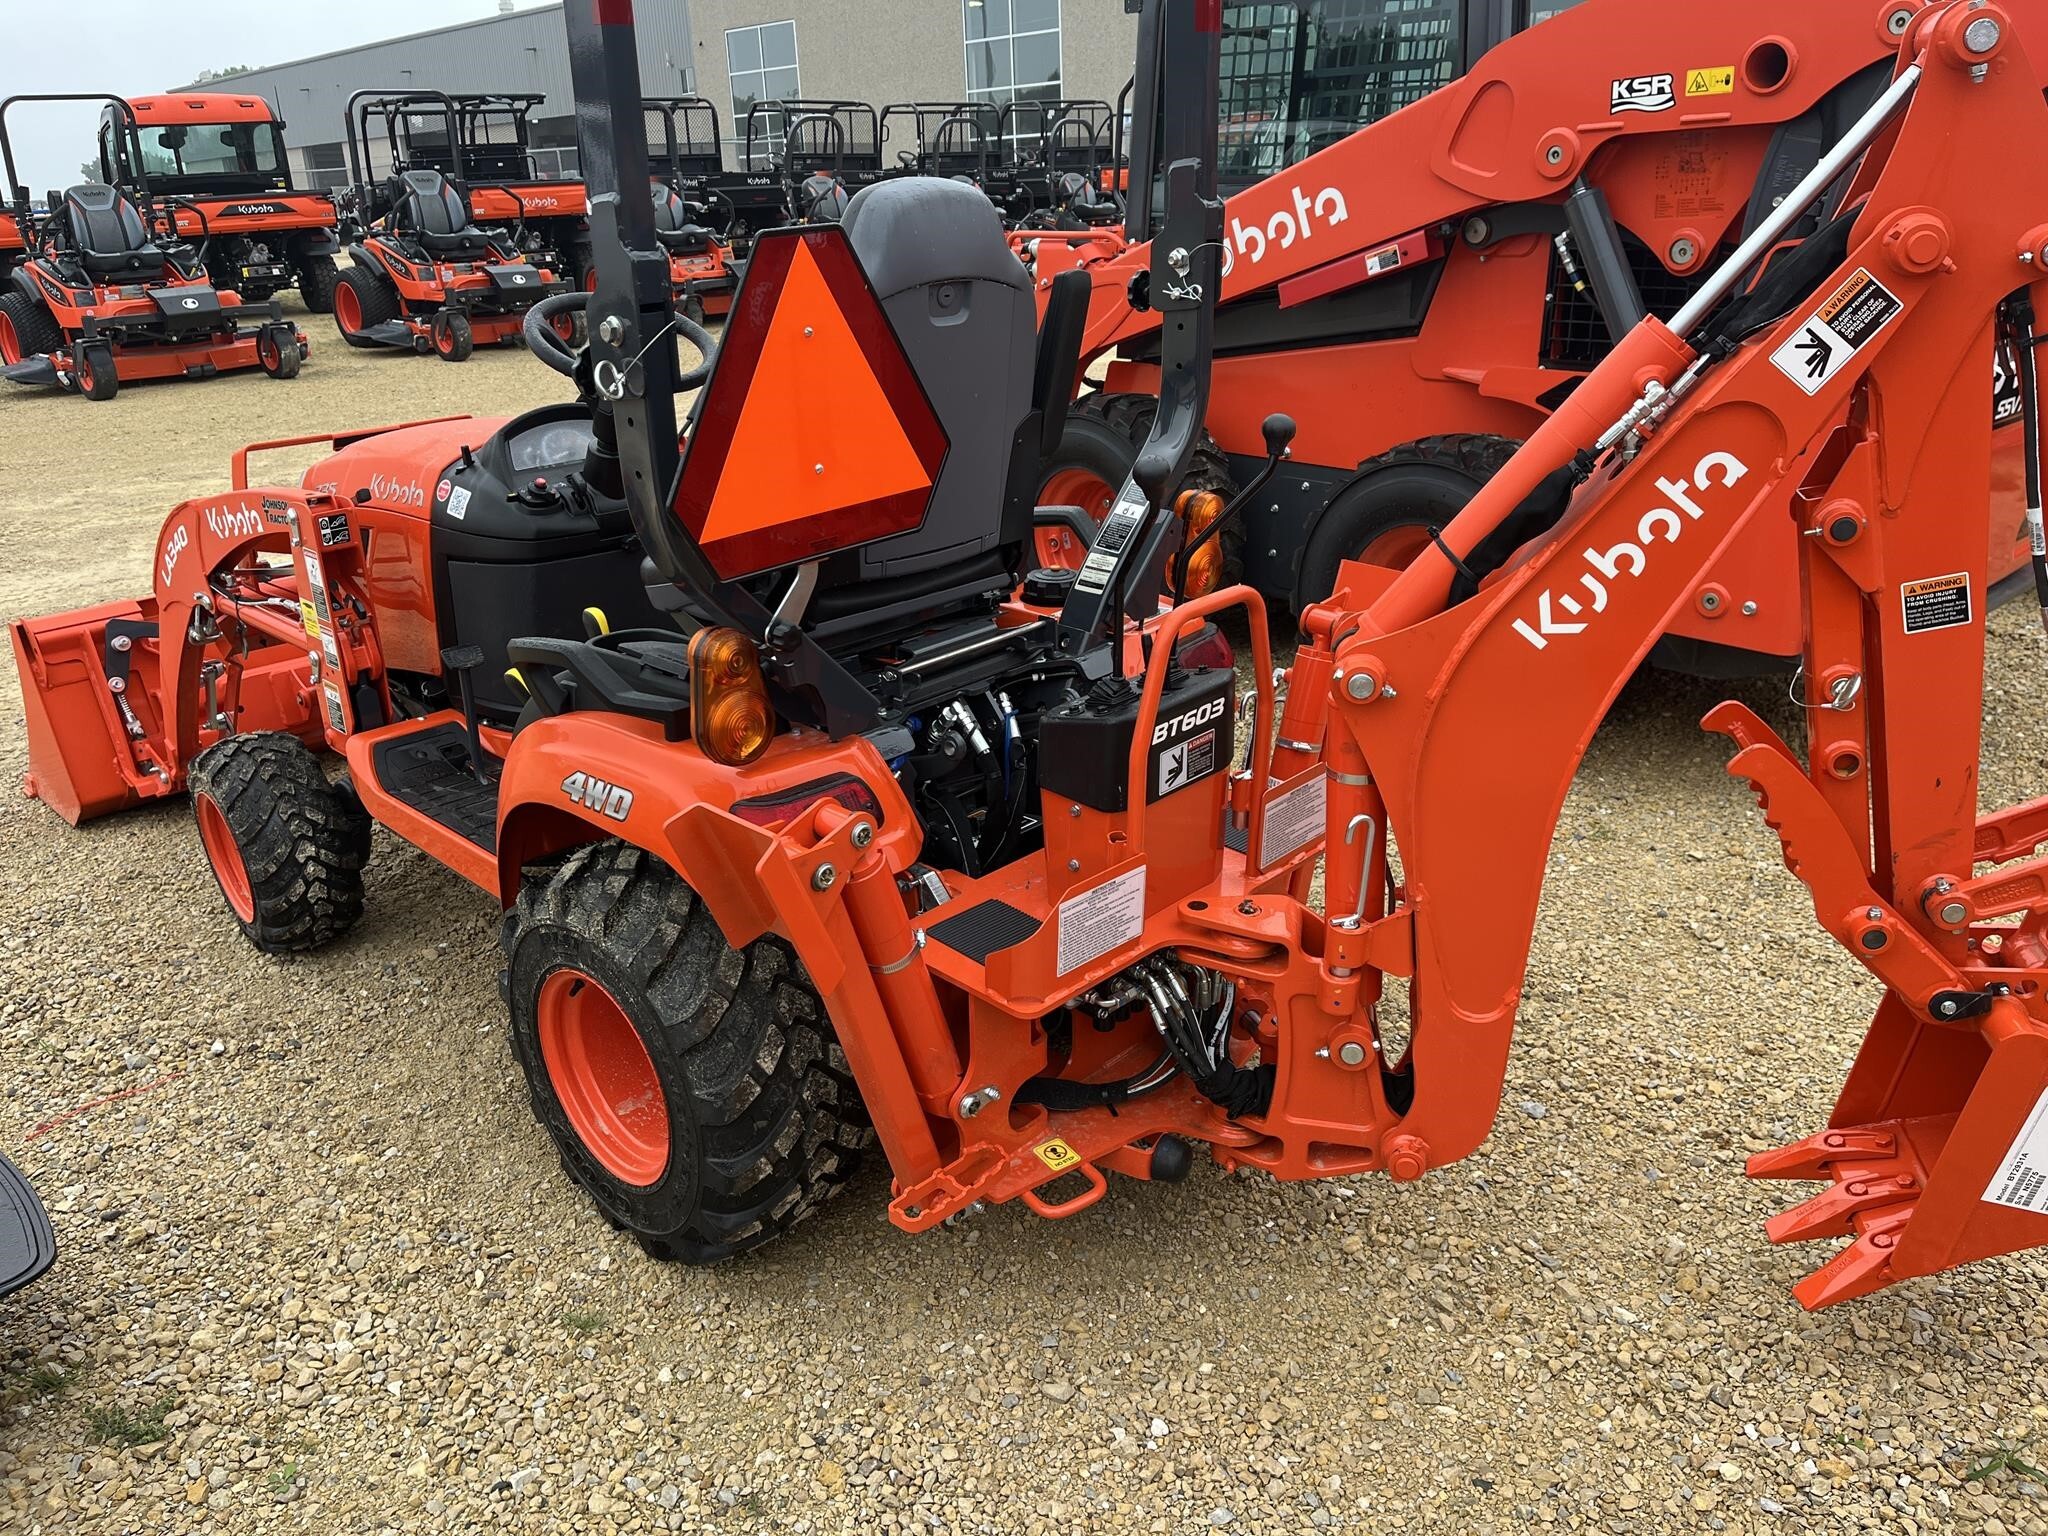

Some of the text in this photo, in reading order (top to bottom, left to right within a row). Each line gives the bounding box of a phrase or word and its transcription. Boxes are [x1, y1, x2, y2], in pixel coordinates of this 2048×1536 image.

[1612, 74, 1673, 100] KSR
[238, 204, 274, 214] Kubota
[522, 197, 558, 207] Kubota
[1222, 186, 1348, 278] ubota
[1830, 277, 1864, 309] WARNING
[1838, 307, 1853, 321] AVOID
[1853, 285, 1877, 308] PERSONAL
[1841, 320, 1853, 332] STAY
[1852, 306, 1868, 319] CLEAR
[1868, 298, 1875, 306] OF
[1845, 298, 1883, 335] OPERATING AREA
[370, 473, 424, 507] Kubota
[206, 502, 264, 540] Kubota
[264, 509, 289, 525] TRACTO
[161, 525, 188, 587] LA340
[1511, 450, 1749, 650] Kubota
[1919, 578, 1962, 591] WARNING
[1152, 697, 1225, 746] BT603
[560, 769, 635, 823] 4WD
[1995, 1153, 2029, 1201] Model BT2931A
[2023, 1171, 2039, 1192] N5775
